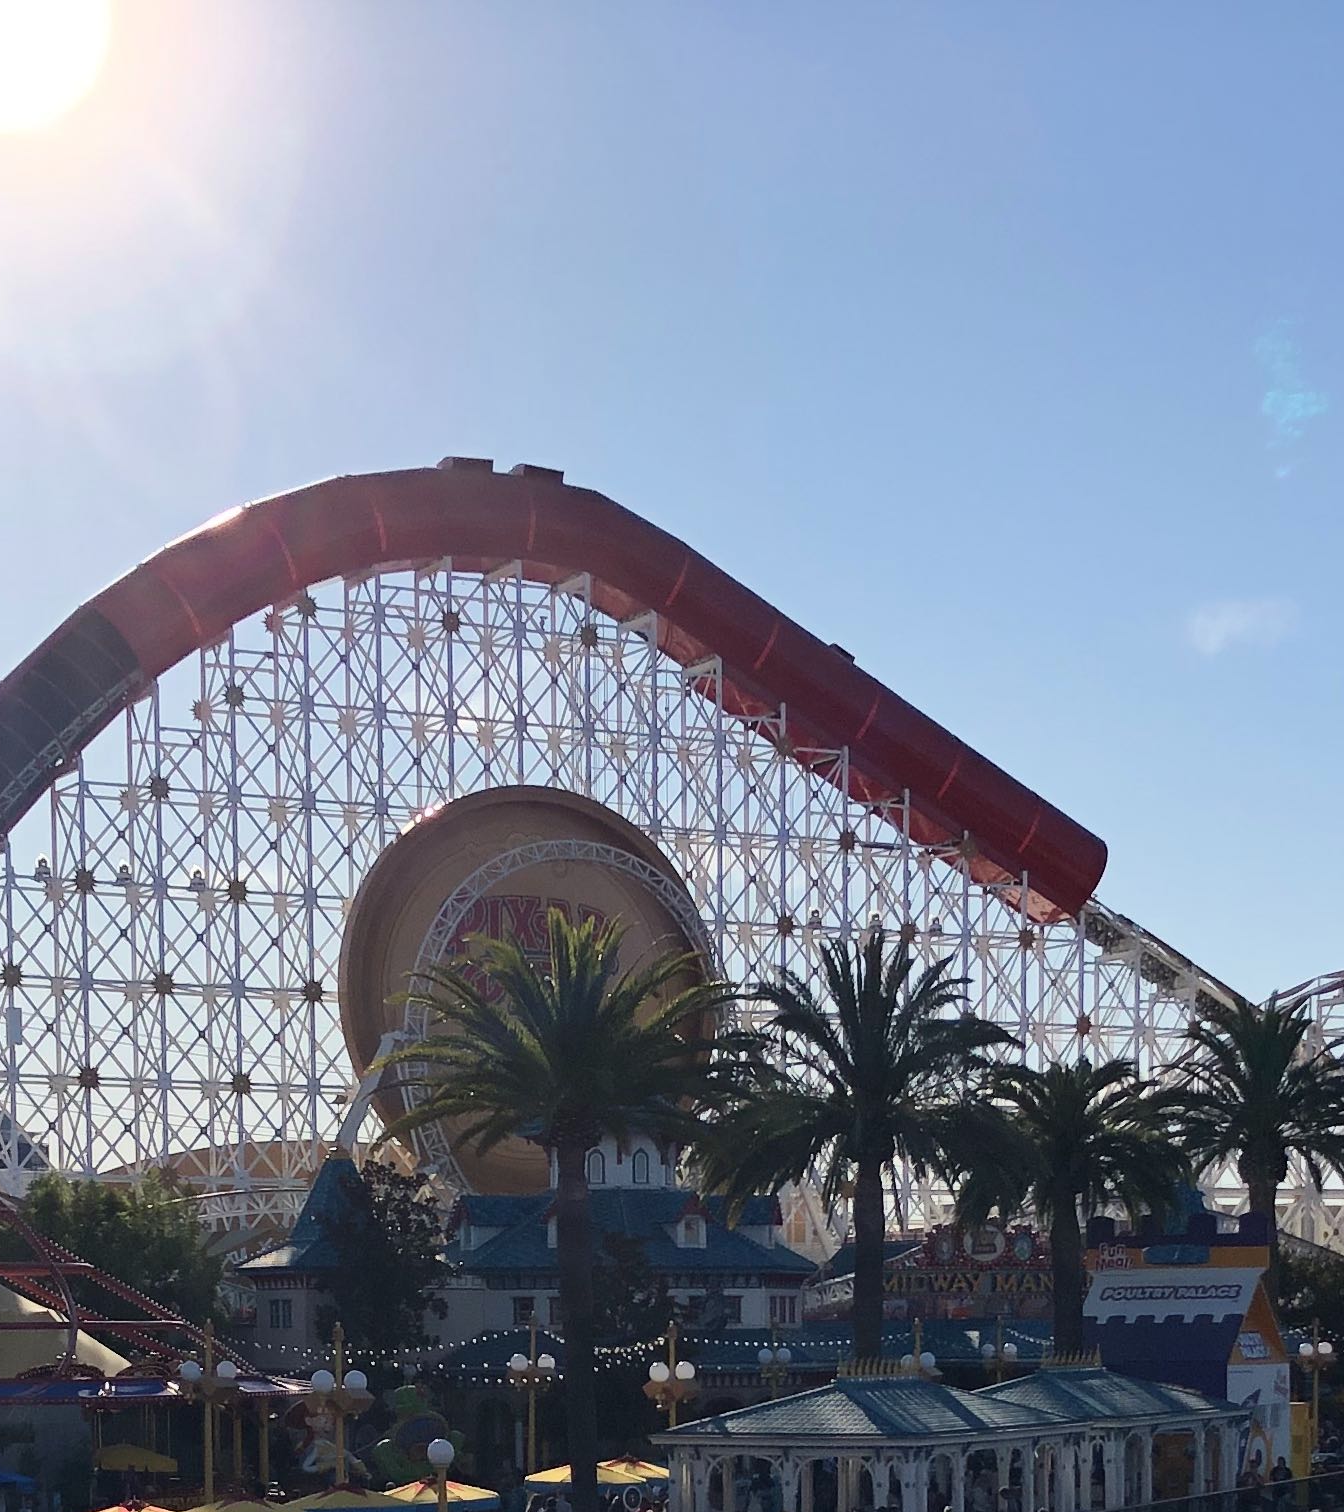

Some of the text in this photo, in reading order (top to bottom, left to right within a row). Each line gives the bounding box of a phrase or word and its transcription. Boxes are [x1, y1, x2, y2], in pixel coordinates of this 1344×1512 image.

[1099, 1242, 1128, 1257] Fun
[1101, 1284, 1243, 1301] POULTRY PALACE
